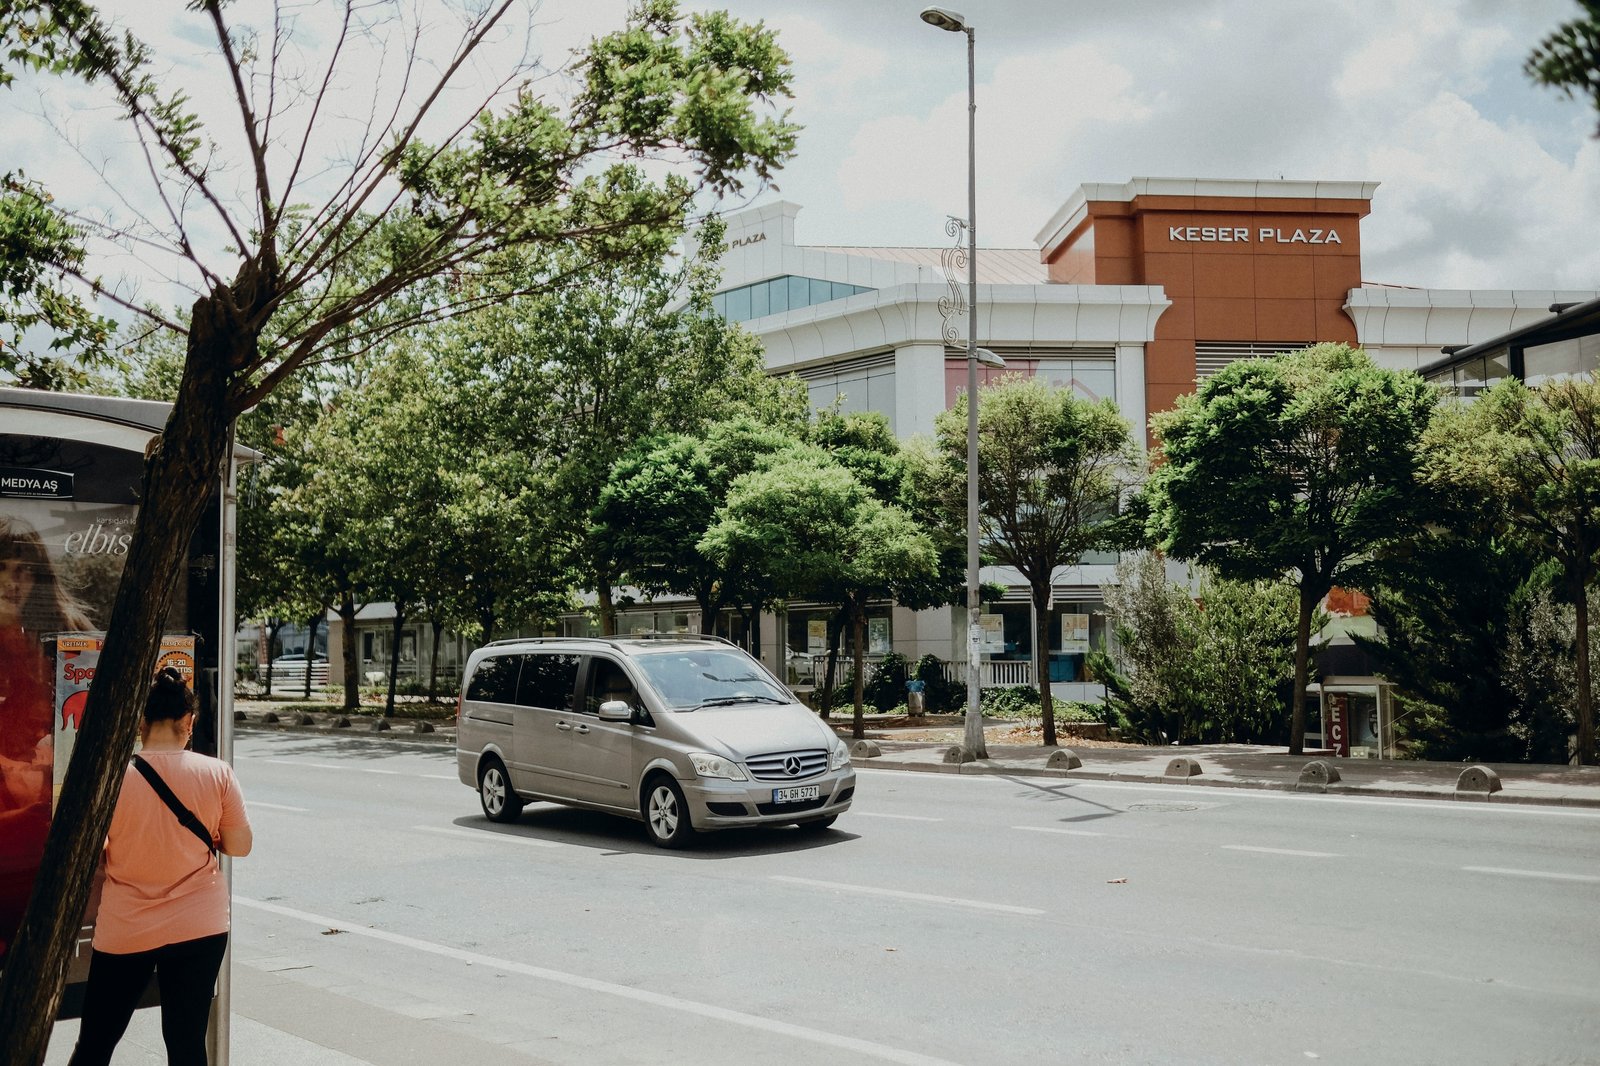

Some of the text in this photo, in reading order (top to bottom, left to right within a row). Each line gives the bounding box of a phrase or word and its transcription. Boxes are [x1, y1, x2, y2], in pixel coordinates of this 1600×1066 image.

[732, 232, 767, 249] PLAZA
[1169, 227, 1342, 244] KESER PLAZA
[1, 477, 58, 492] MEDYA AŞ
[65, 524, 133, 555] elbis
[779, 790, 788, 799] 34
[789, 789, 799, 798] GH
[800, 787, 817, 797] 5721
